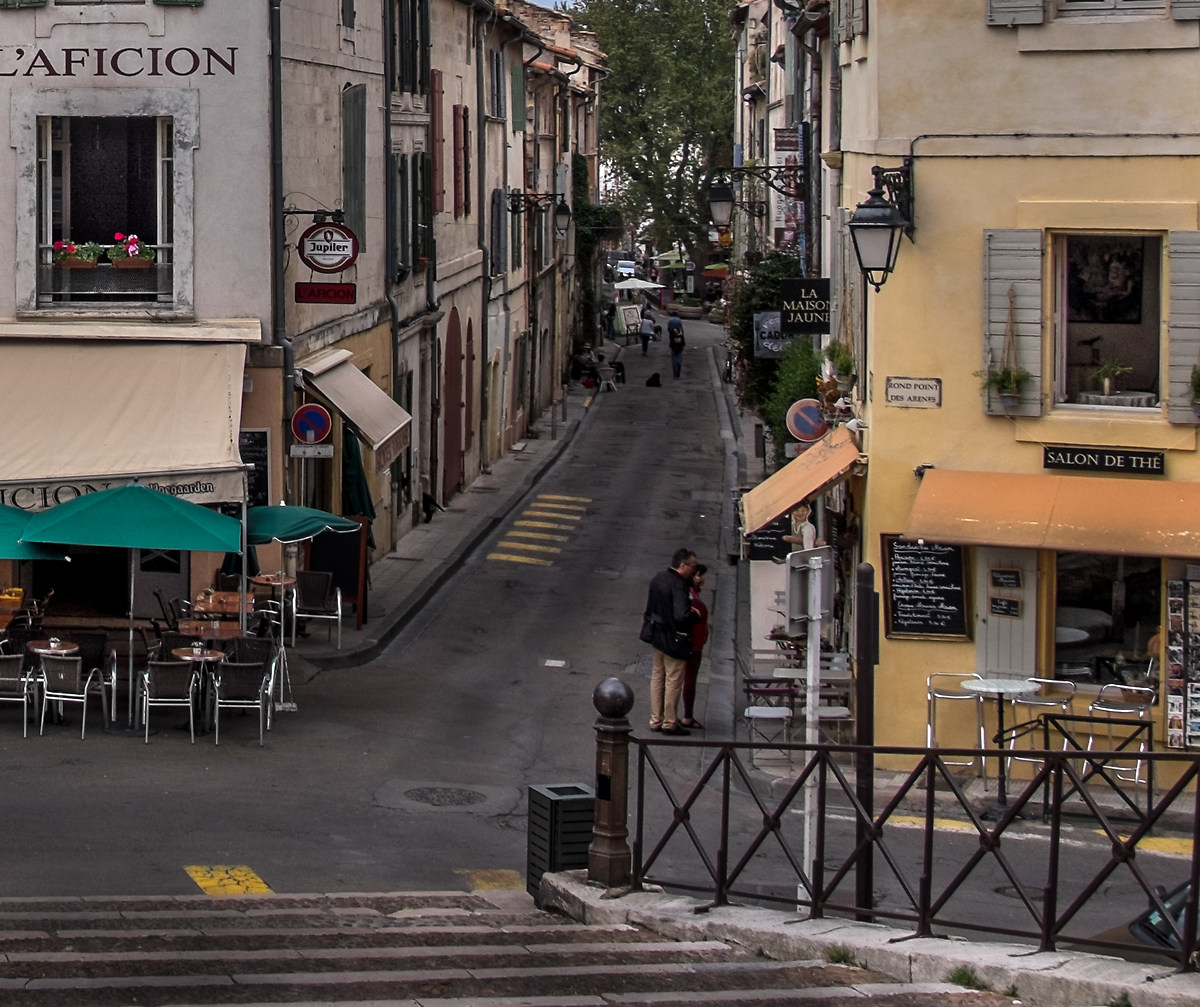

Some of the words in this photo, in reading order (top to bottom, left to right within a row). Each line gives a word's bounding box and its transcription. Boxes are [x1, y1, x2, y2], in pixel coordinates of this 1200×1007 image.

[310, 242, 349, 253] Jupiler
[297, 287, 355, 299] L'AFICION
[801, 288, 818, 299] LA
[888, 382, 912, 390] ROND
[913, 383, 938, 391] POINT
[890, 394, 904, 402] DES
[1047, 451, 1099, 466] SALON
[1104, 454, 1125, 468] DE
